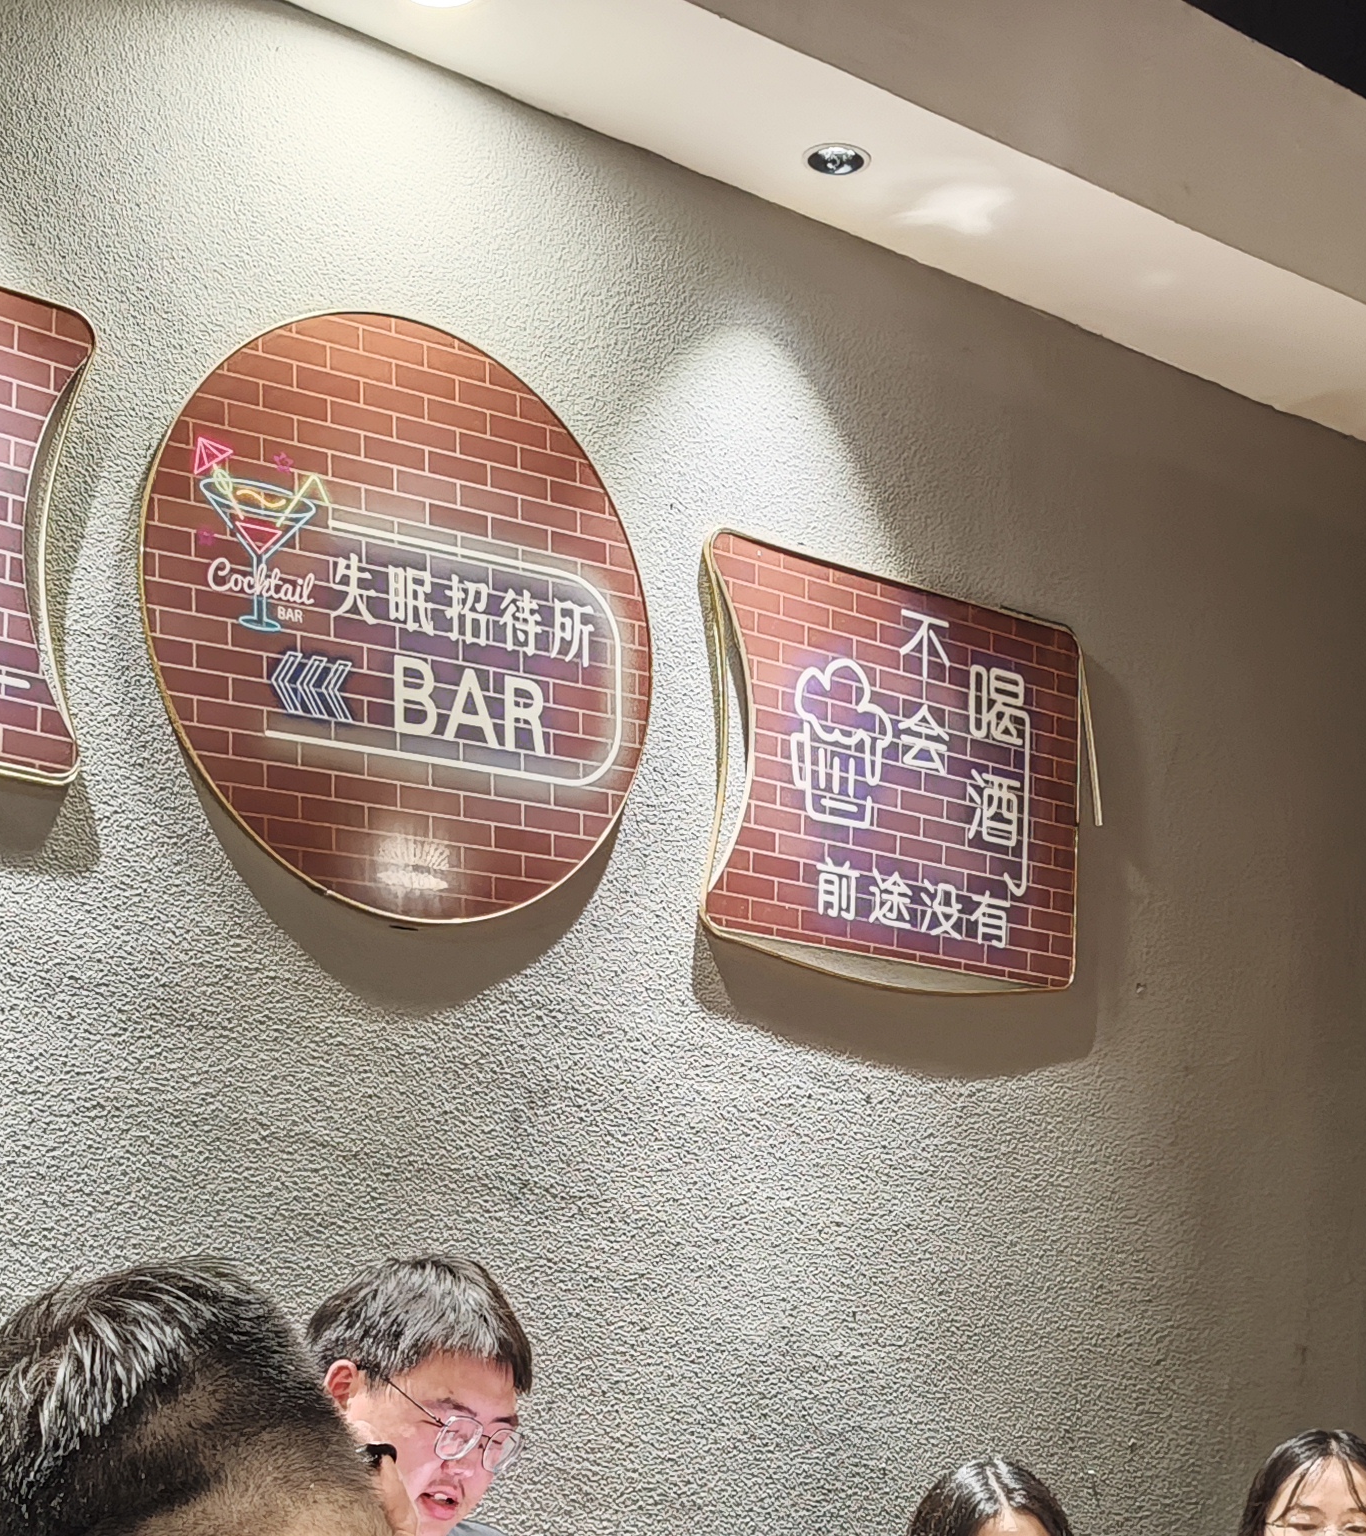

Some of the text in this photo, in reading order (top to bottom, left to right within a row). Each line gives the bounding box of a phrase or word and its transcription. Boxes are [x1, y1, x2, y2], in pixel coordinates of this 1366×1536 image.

[207, 557, 316, 605] Cocktail
[277, 605, 304, 624] BAR
[331, 553, 596, 668] 失眠招待所
[393, 655, 546, 756] BAR
[816, 856, 1010, 948] 前途没有
